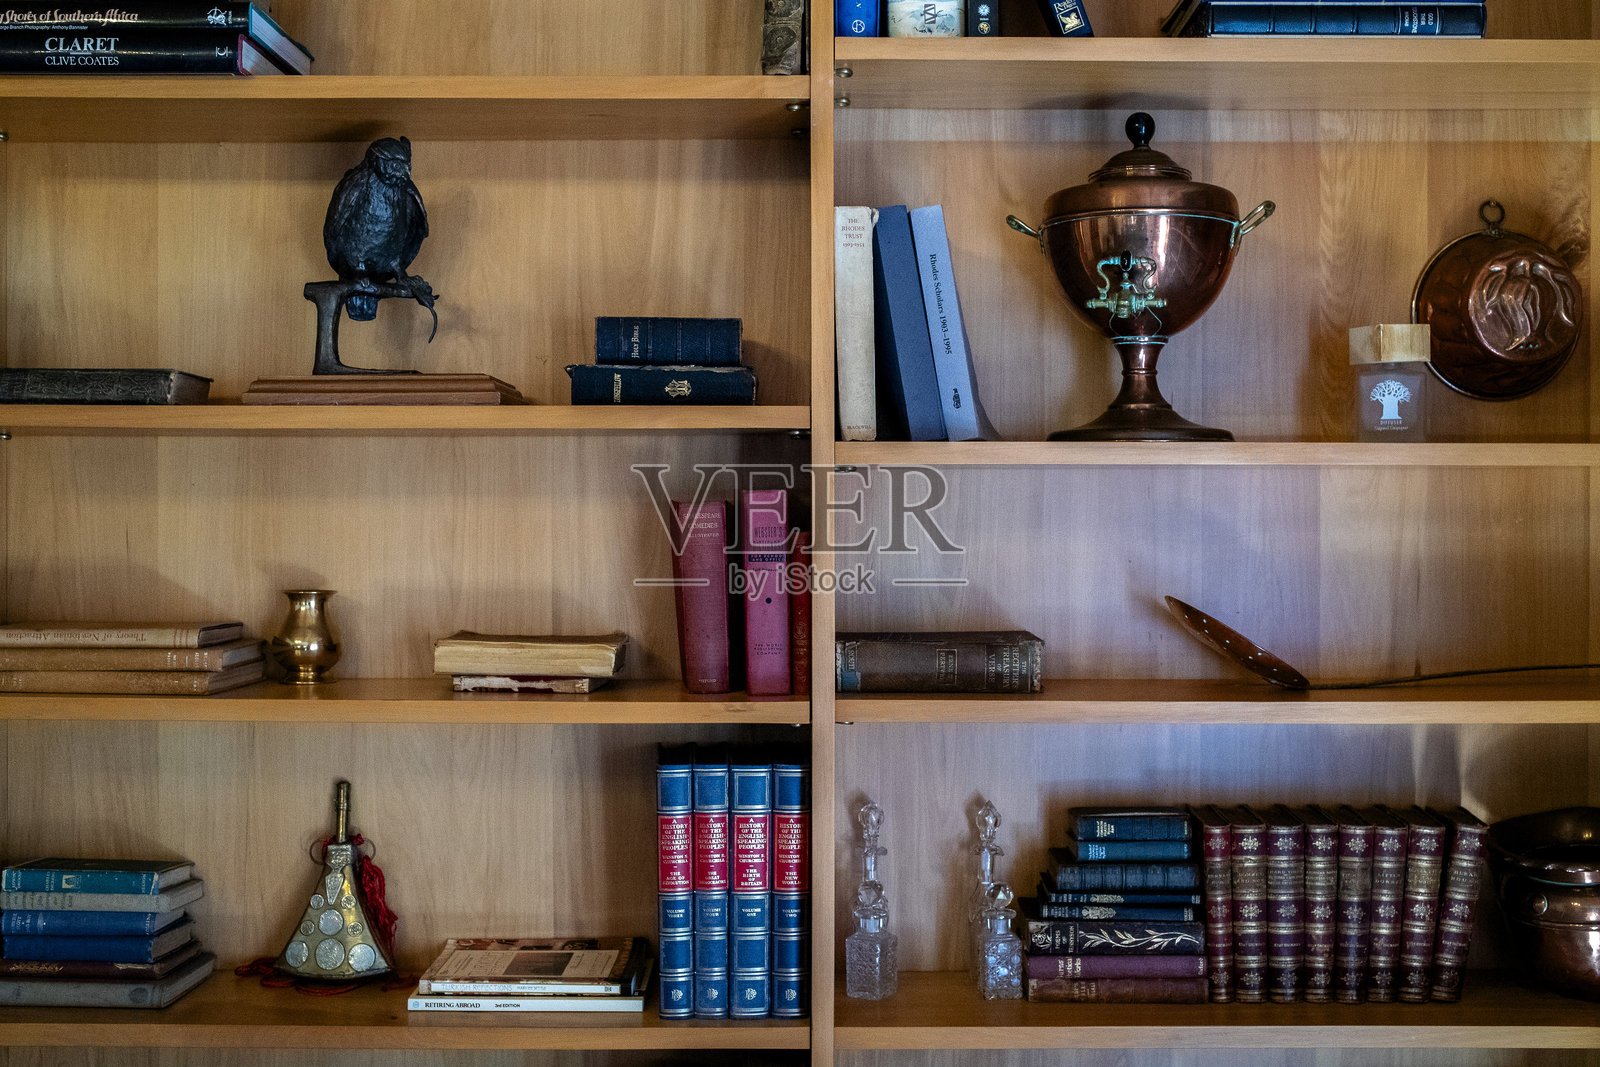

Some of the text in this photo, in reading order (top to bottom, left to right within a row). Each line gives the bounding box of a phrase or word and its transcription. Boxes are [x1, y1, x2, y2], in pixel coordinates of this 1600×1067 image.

[4, 8, 139, 26] Shores of Southern Africa
[45, 37, 119, 51] CLARET
[45, 56, 119, 65] CLIVE COATES
[929, 253, 938, 281] Rhodes
[933, 282, 944, 314] Scholars
[6, 631, 146, 641] Theory of Newtonian Attraction
